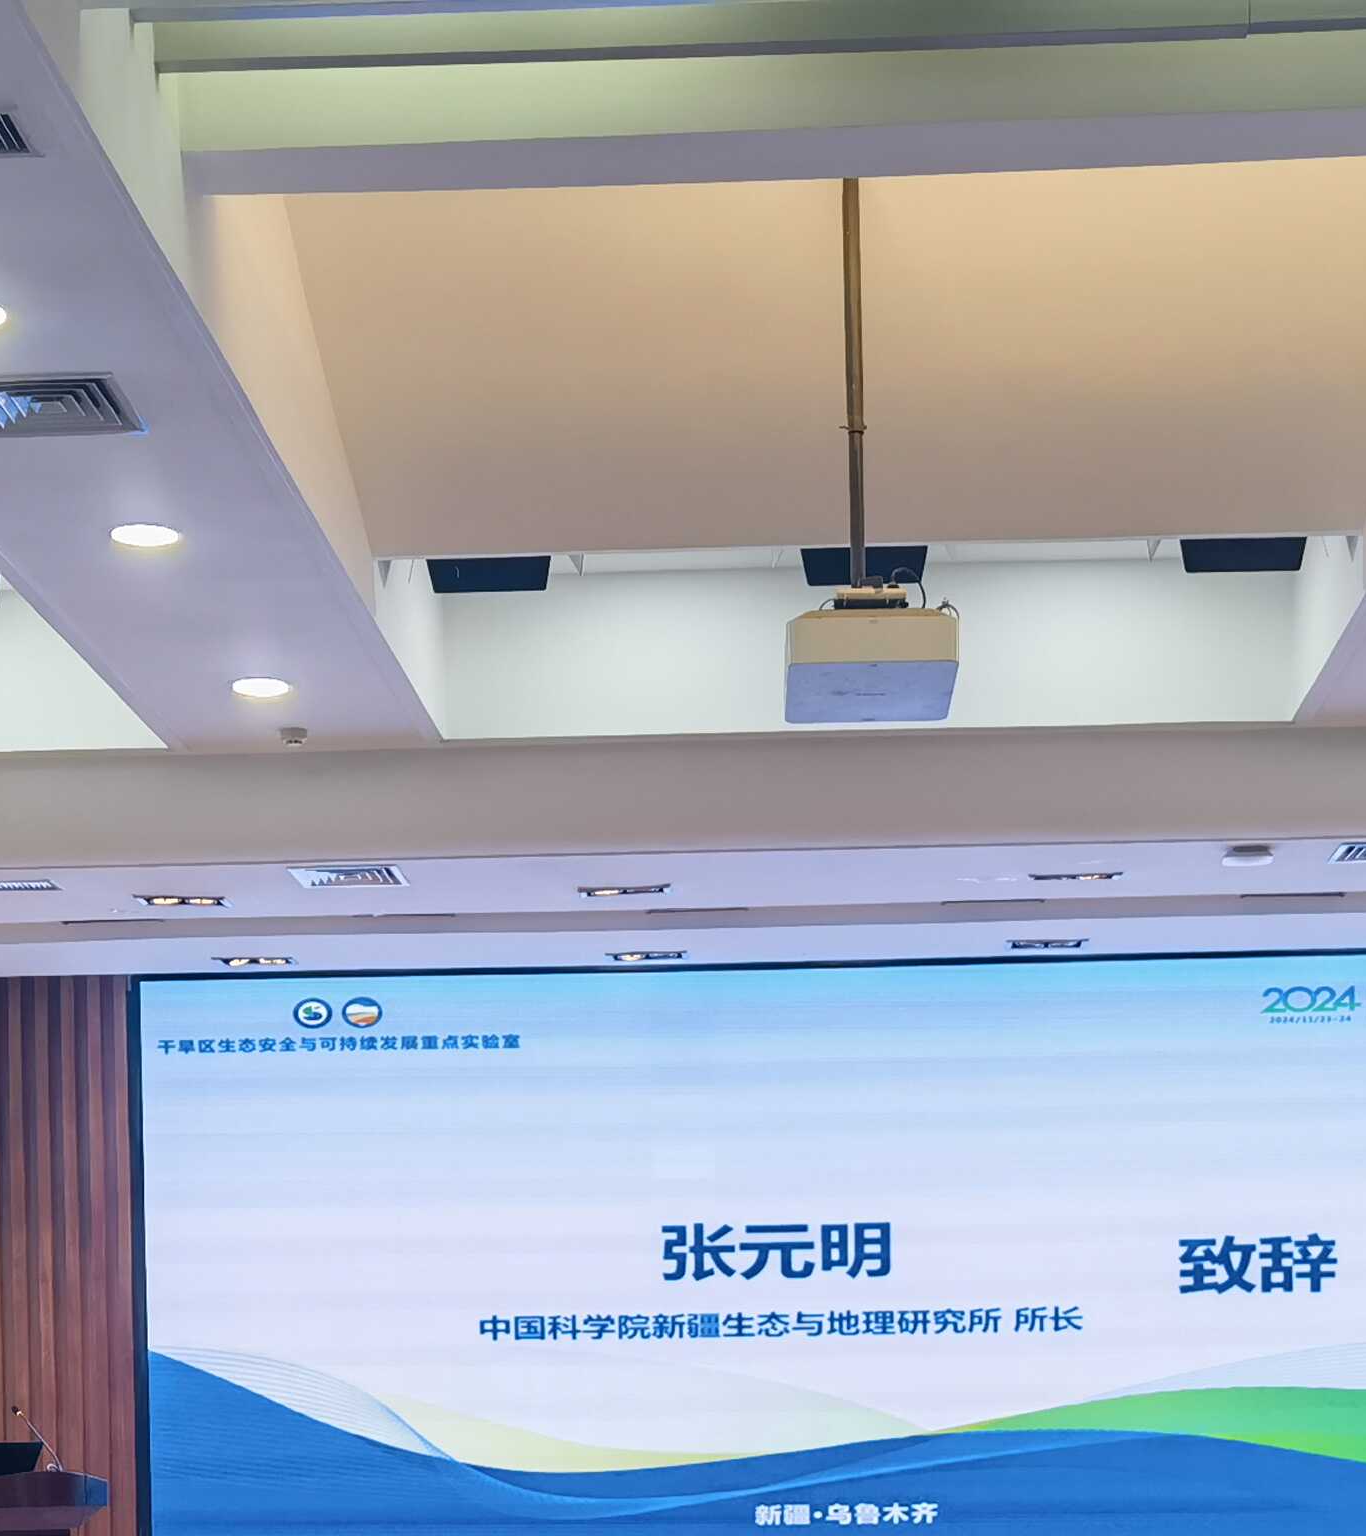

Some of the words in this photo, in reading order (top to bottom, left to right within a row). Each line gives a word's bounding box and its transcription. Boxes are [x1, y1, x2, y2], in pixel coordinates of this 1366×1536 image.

[1260, 985, 1362, 1014] 2024
[157, 1034, 520, 1055] 干旱区生态安全与可持续发展重点实验室
[661, 1221, 892, 1282] 张元明
[1177, 1233, 1339, 1296] 致辞
[478, 1307, 1003, 1342] 中国科学院新疆生态与地理研究所
[1013, 1305, 1084, 1335] 所长
